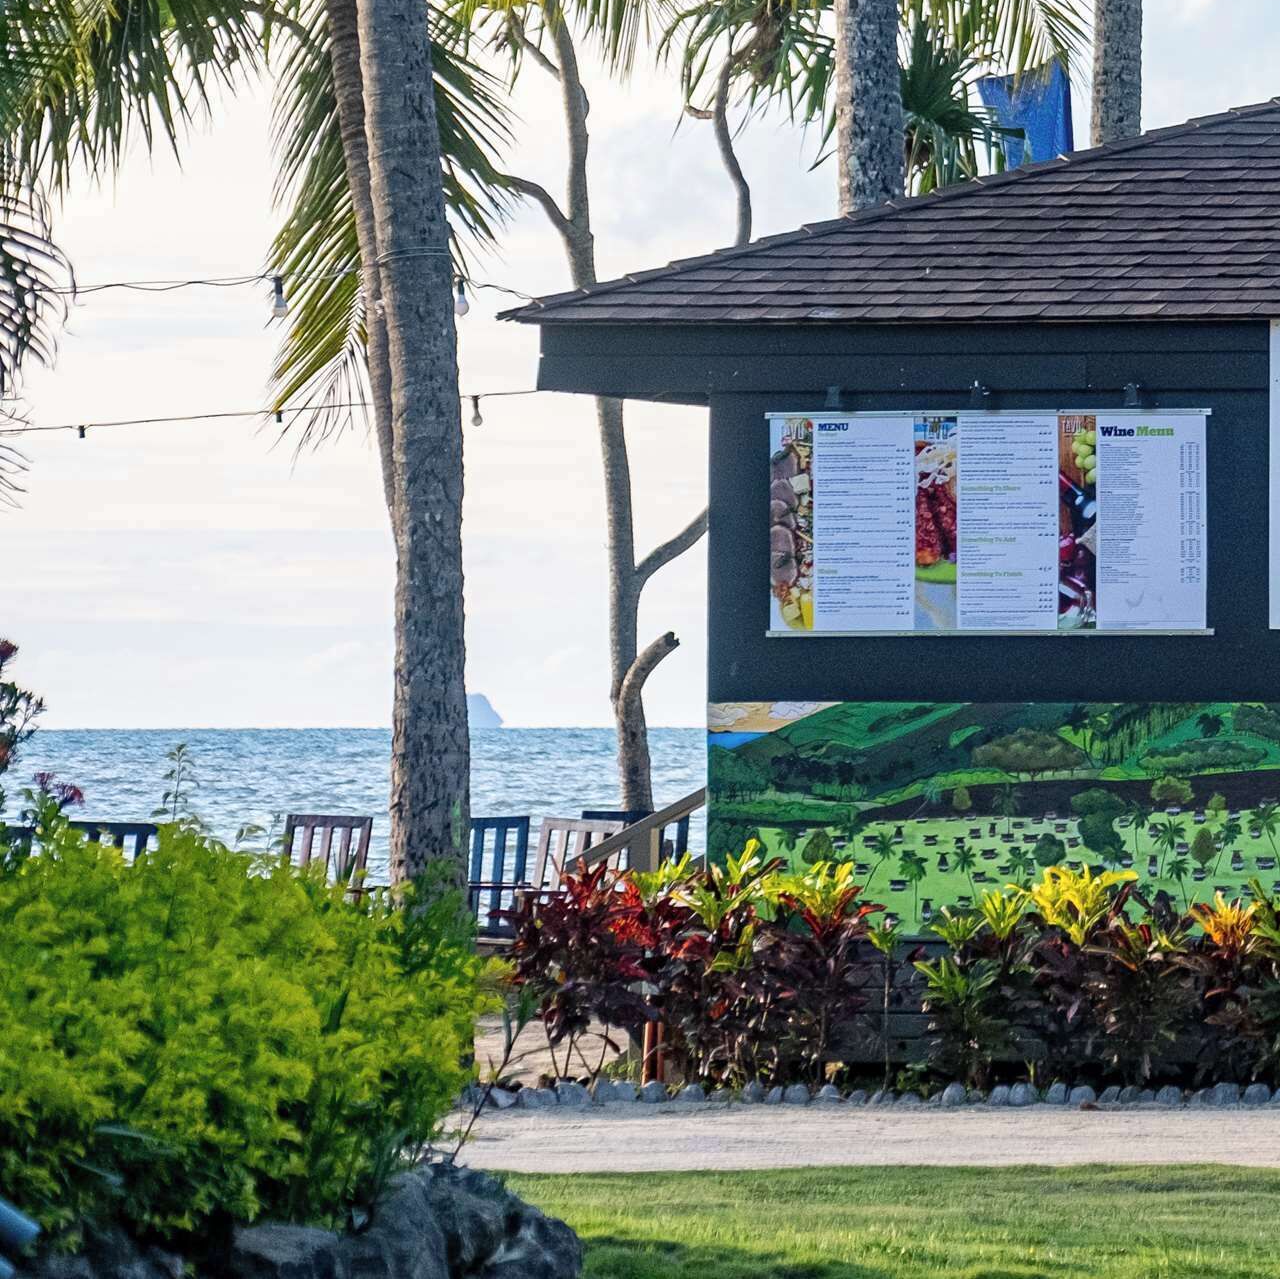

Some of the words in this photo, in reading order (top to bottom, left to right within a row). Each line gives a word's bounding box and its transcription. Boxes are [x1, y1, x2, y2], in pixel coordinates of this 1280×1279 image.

[817, 423, 849, 432] MENU
[1100, 425, 1135, 437] Wine
[1136, 425, 1175, 437] Menu
